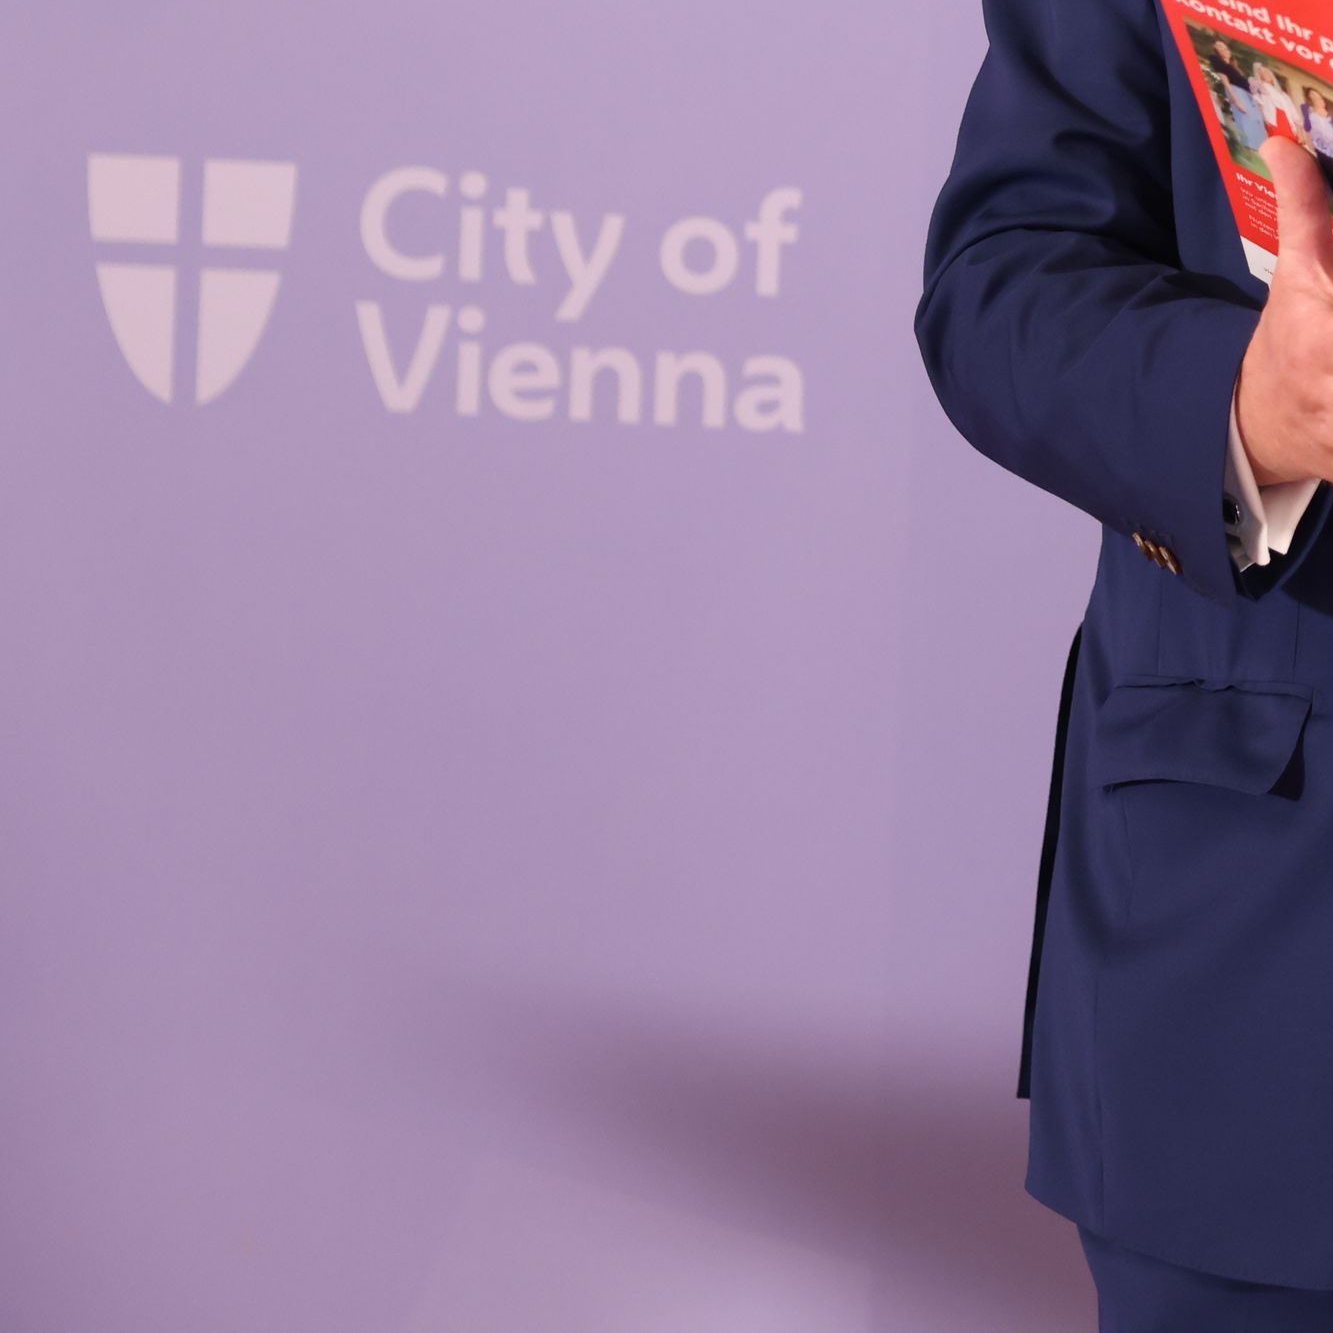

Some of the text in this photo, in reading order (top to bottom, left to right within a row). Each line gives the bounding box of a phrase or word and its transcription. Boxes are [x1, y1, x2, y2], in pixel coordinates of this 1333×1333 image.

[1276, 14, 1313, 41] Ihr
[1280, 37, 1324, 64] vor
[359, 165, 803, 322] City of
[354, 299, 805, 434] Vienna
